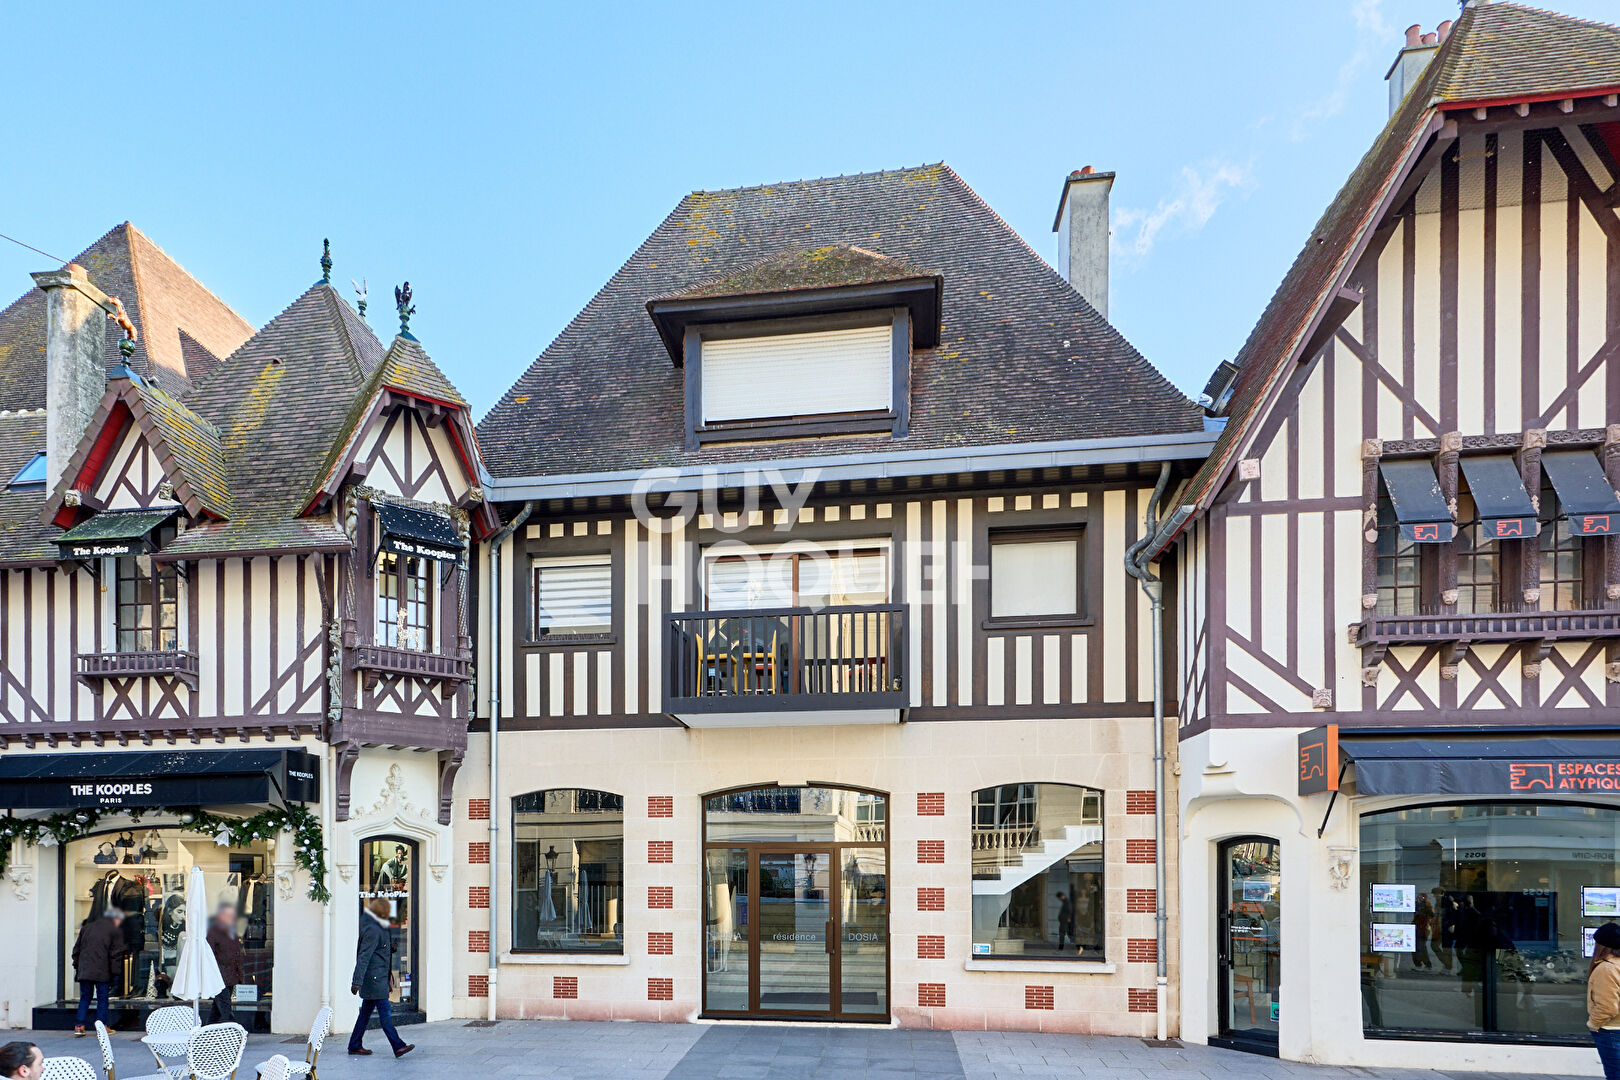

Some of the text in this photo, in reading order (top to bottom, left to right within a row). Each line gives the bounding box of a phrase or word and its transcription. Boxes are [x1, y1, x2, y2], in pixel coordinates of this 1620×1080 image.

[73, 545, 129, 556] The Kooples
[393, 540, 456, 560] The Kooples
[70, 783, 152, 796] THE KOOPLES
[773, 933, 816, 941] résidence
[848, 933, 879, 941] DOSIA
